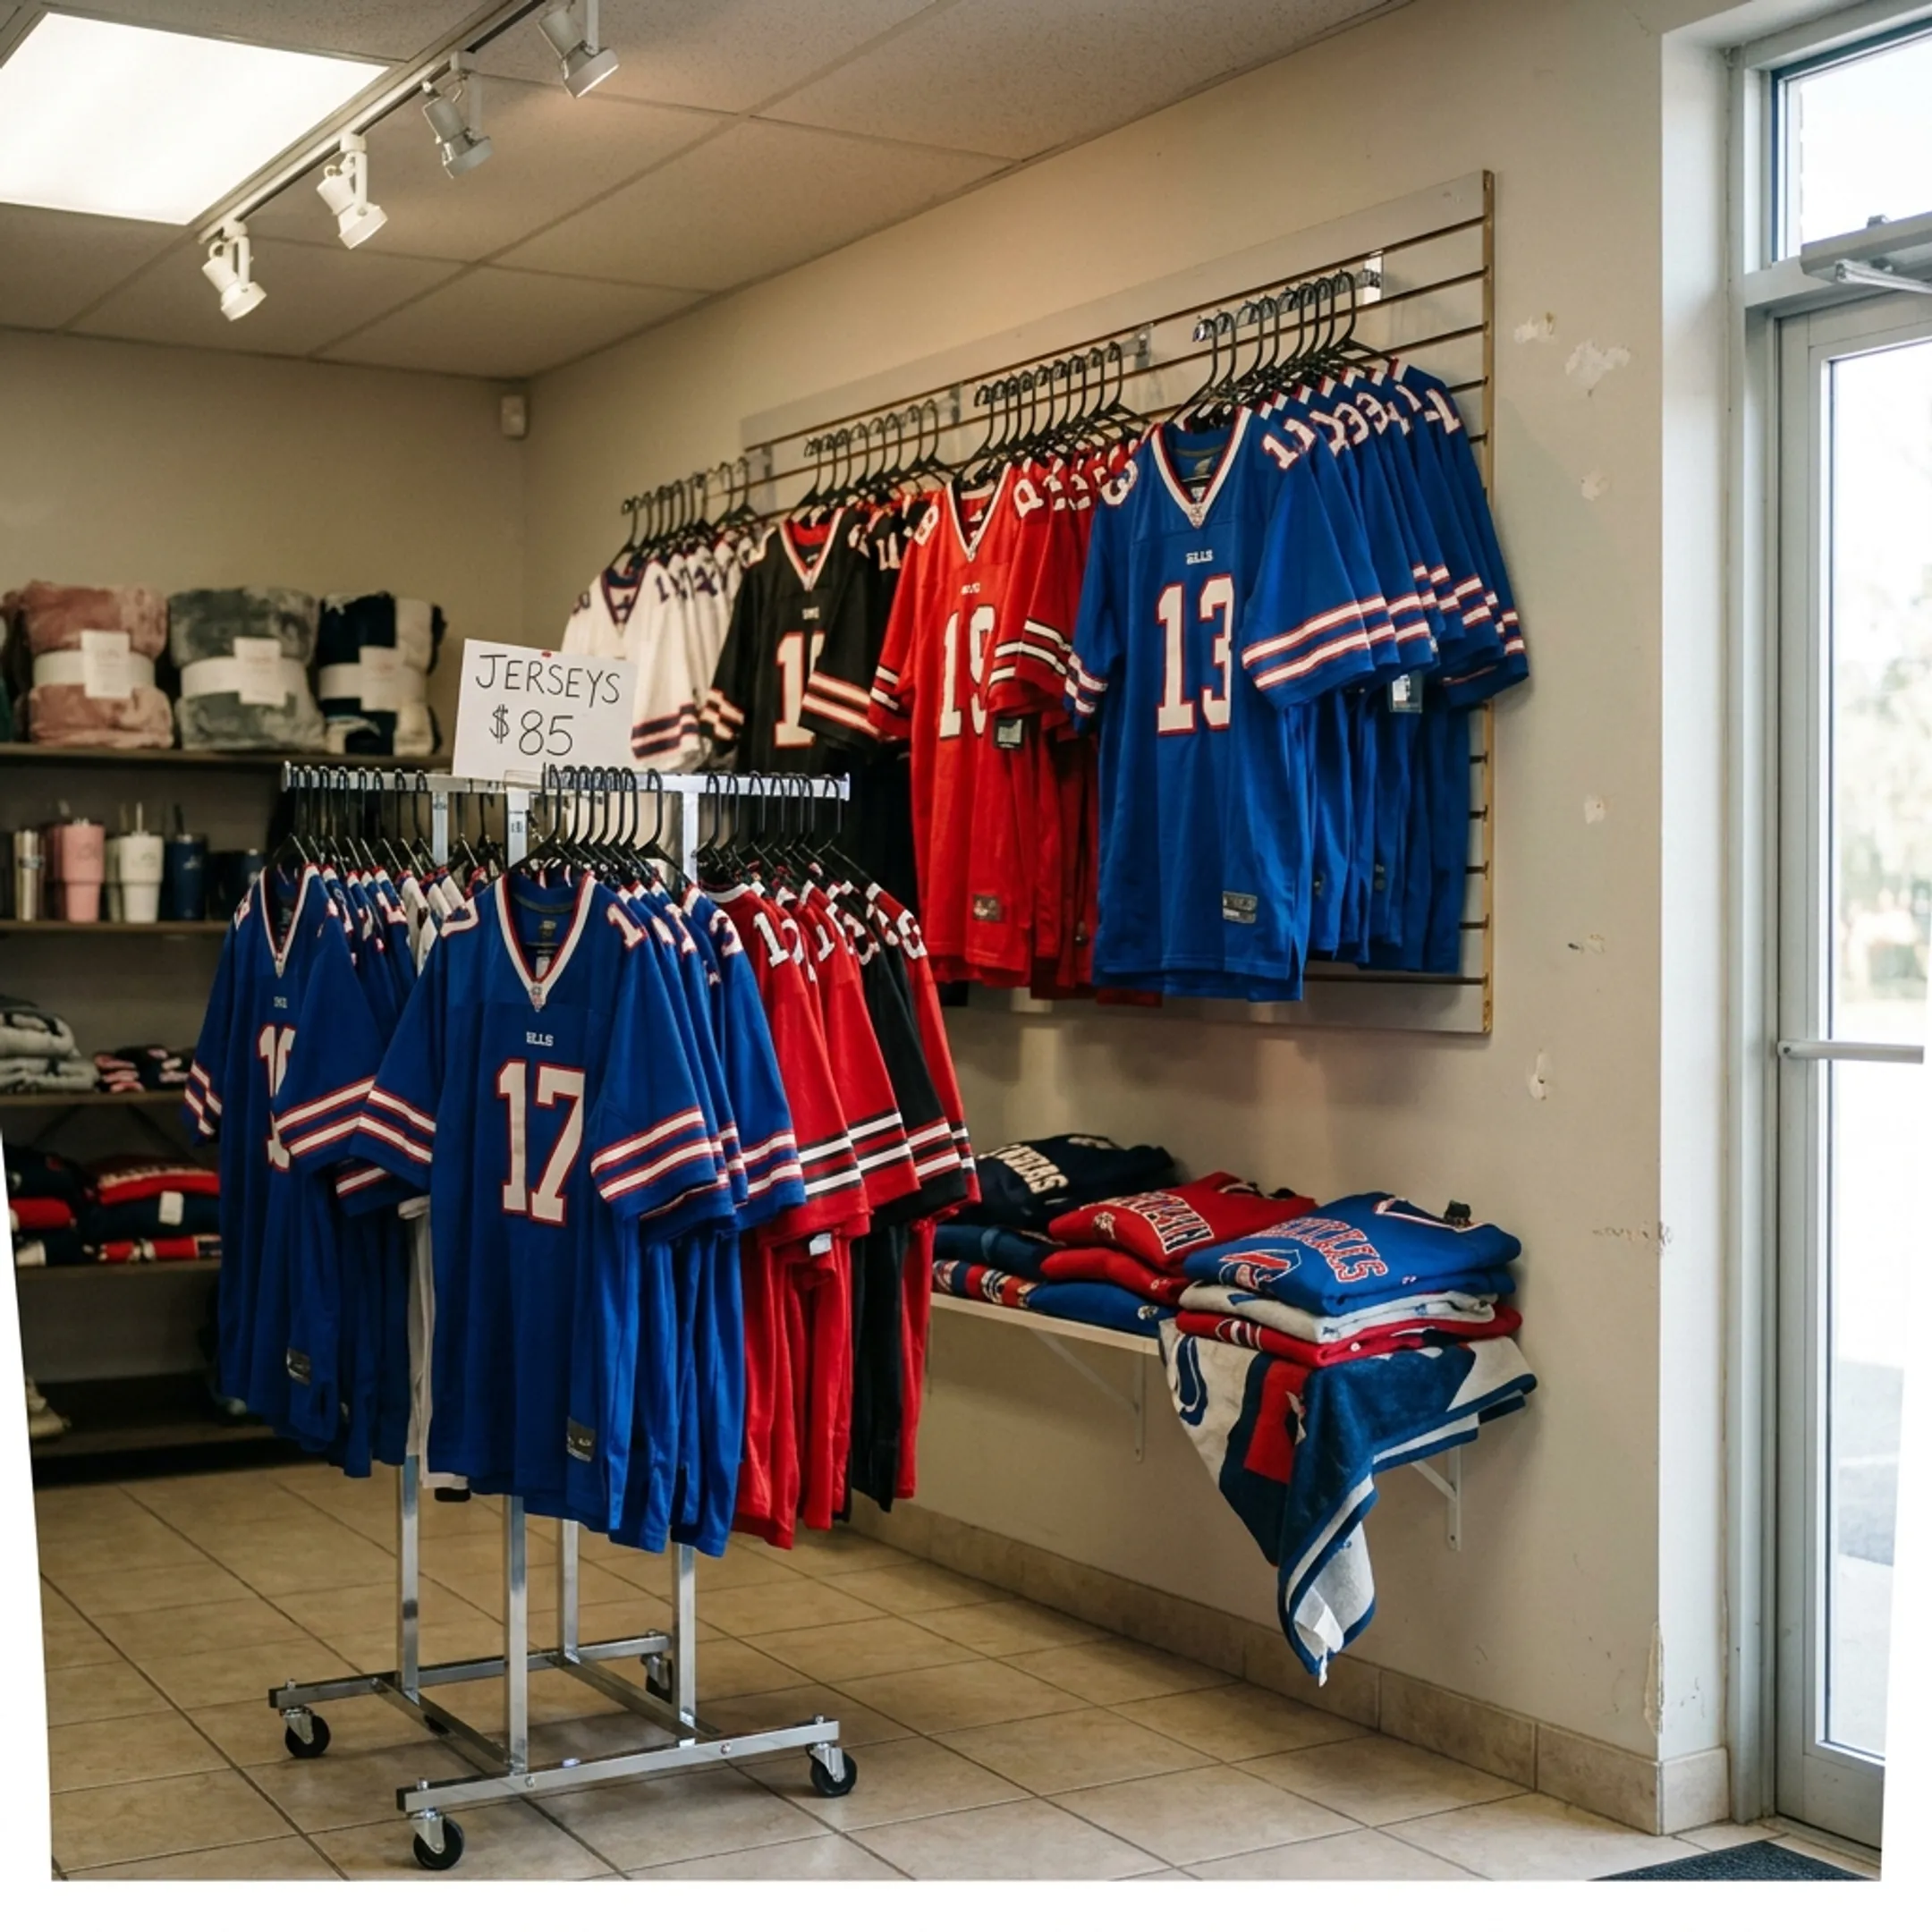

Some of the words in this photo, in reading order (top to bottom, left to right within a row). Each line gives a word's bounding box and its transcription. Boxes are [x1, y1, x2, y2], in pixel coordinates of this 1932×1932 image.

[475, 654, 622, 708] JERSEYS
[774, 631, 826, 750] 1
[1157, 573, 1234, 735] 13
[489, 704, 574, 756] $85
[496, 1058, 586, 1226] 17
